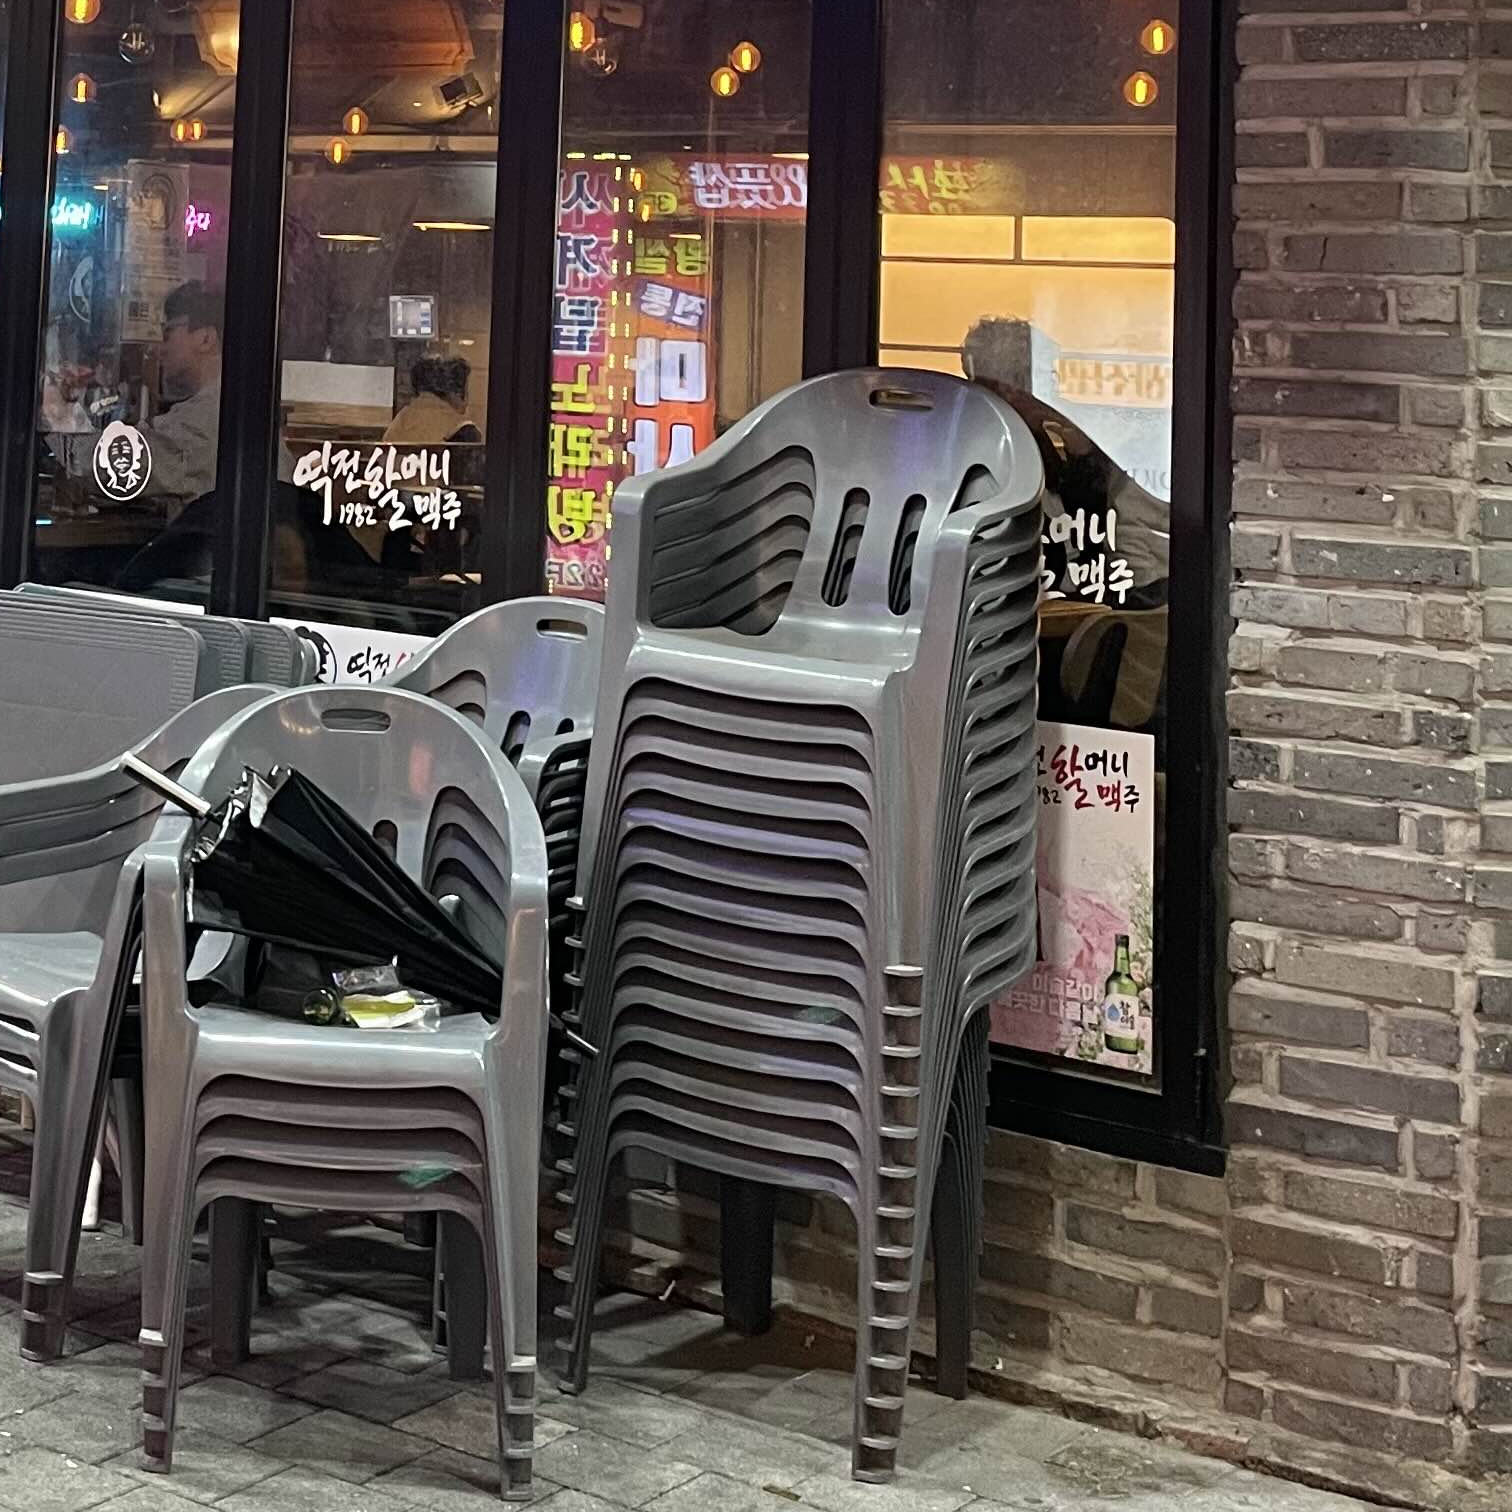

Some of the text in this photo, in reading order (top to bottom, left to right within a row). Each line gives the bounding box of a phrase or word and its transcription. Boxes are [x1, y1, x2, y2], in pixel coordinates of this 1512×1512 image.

[412, 487, 463, 531] 맥주
[1068, 553, 1135, 606] 맥주
[1096, 780, 1140, 814] 맥주
